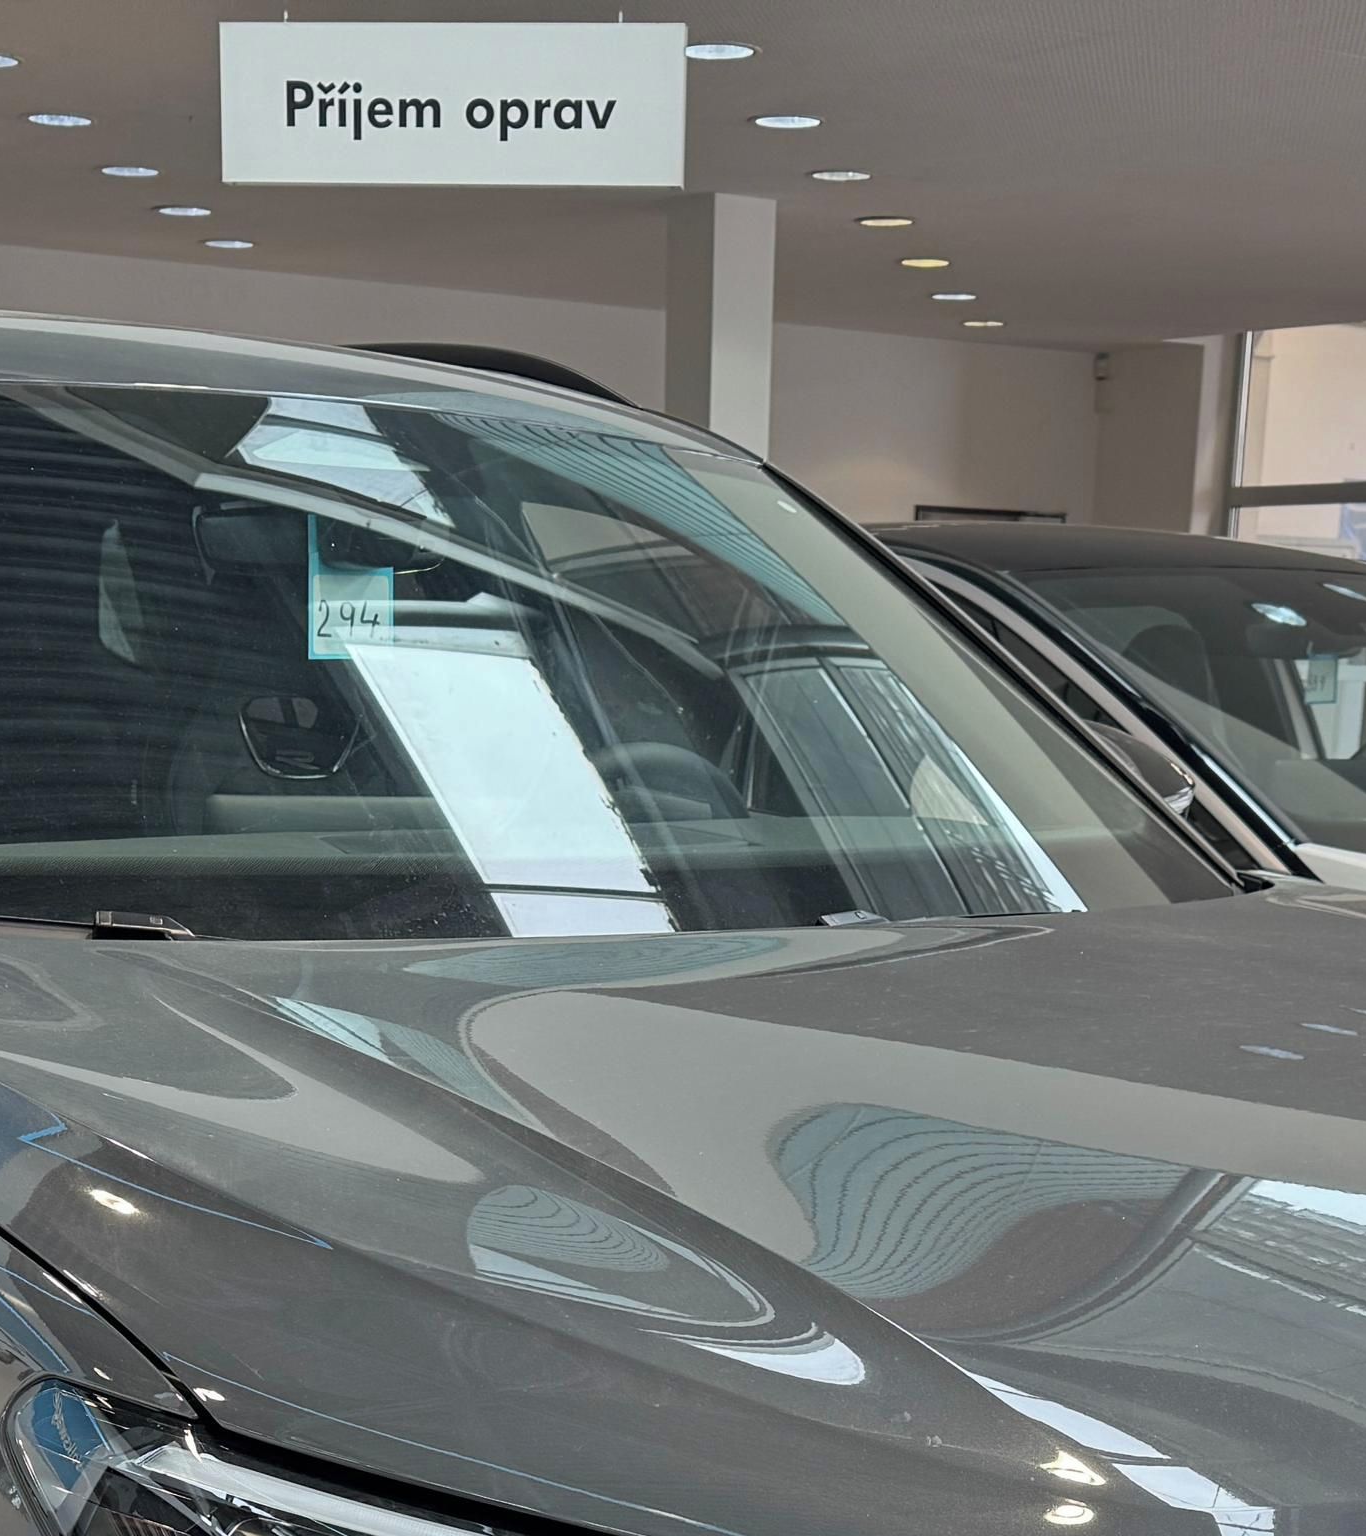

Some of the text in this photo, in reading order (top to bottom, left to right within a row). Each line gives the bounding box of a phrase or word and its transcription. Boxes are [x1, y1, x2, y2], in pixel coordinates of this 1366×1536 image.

[285, 80, 617, 141] Příjem oprav
[316, 599, 380, 638] 294
